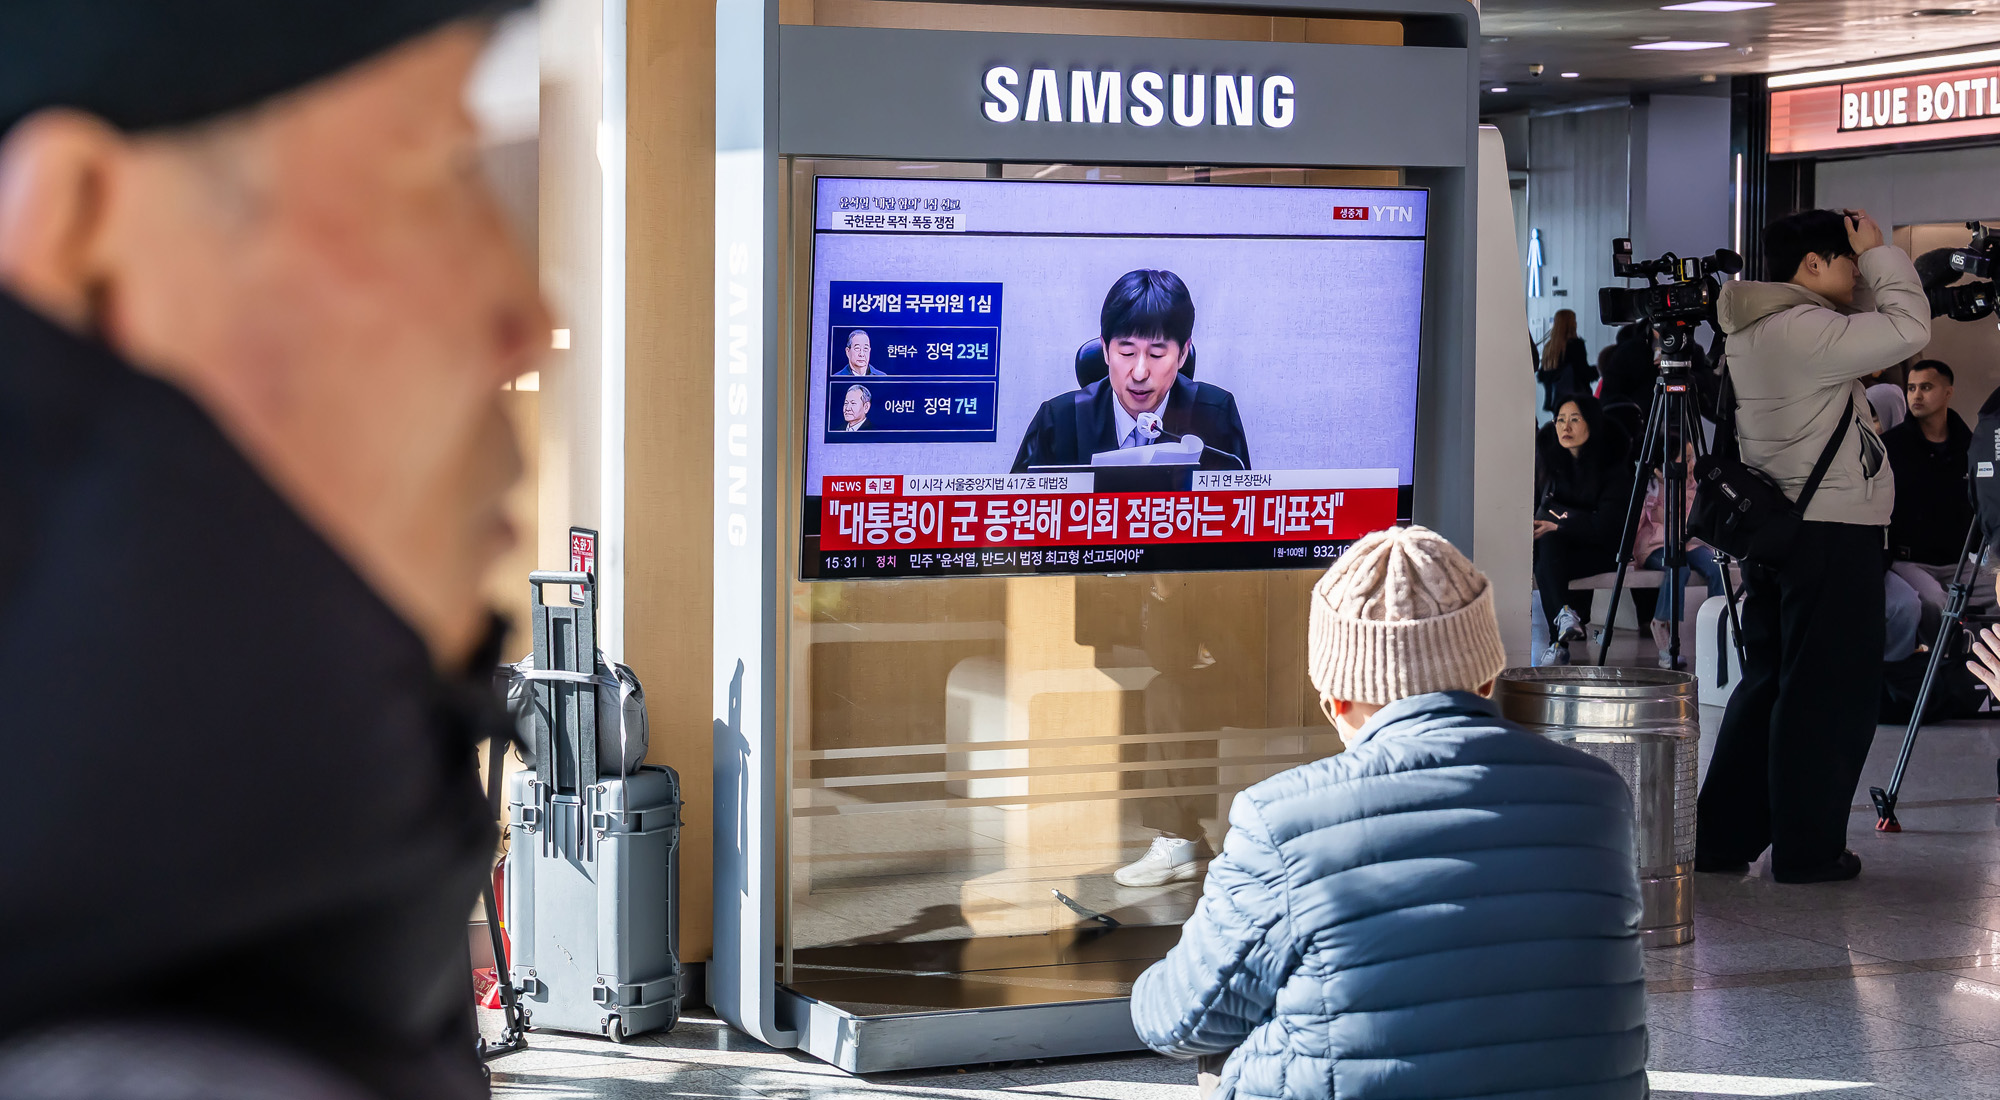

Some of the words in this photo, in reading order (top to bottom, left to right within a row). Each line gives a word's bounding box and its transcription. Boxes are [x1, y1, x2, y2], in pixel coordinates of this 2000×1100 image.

[981, 66, 1295, 128] SAMSUNG
[1843, 87, 1908, 129] BLUE
[1340, 208, 1363, 218] 생중계
[1372, 205, 1412, 222] YTN
[844, 215, 885, 228] 국헌문란
[934, 216, 954, 229] 쟁점
[1951, 253, 1965, 265] KBS
[843, 294, 901, 312] 비상계엄
[905, 294, 963, 313] 국무위원
[968, 295, 991, 313] 1심
[887, 345, 918, 358] 한덕수
[926, 343, 953, 360] 징역
[957, 343, 988, 360] 23년
[728, 242, 748, 547] SAMSUNG
[885, 400, 915, 413] 이상민
[924, 397, 951, 415] 징역
[955, 397, 977, 414] 7년
[831, 481, 861, 492] NEWS
[910, 479, 920, 491] 이
[922, 478, 943, 491] 시각
[945, 477, 1004, 491] 서울중앙지법
[1007, 477, 1036, 490] 417호
[1039, 477, 1068, 490] 대법정
[1234, 474, 1272, 487] 부장판사
[829, 500, 944, 544] "대통령이
[951, 501, 978, 542] 군
[984, 499, 1062, 542] 동원해
[1068, 498, 1118, 540] 의회
[1125, 496, 1225, 538] 점령하는
[1231, 496, 1255, 536] 게
[1263, 492, 1344, 535] 대표적"
[573, 537, 593, 552] 소화기
[825, 556, 857, 569] 15:31
[876, 555, 897, 568] 정치
[909, 553, 934, 568] 민주
[982, 551, 1016, 566] 반드시
[1020, 551, 1042, 566] 법정
[1045, 550, 1080, 565] 최고형
[1082, 549, 1144, 564] 선고되어야"
